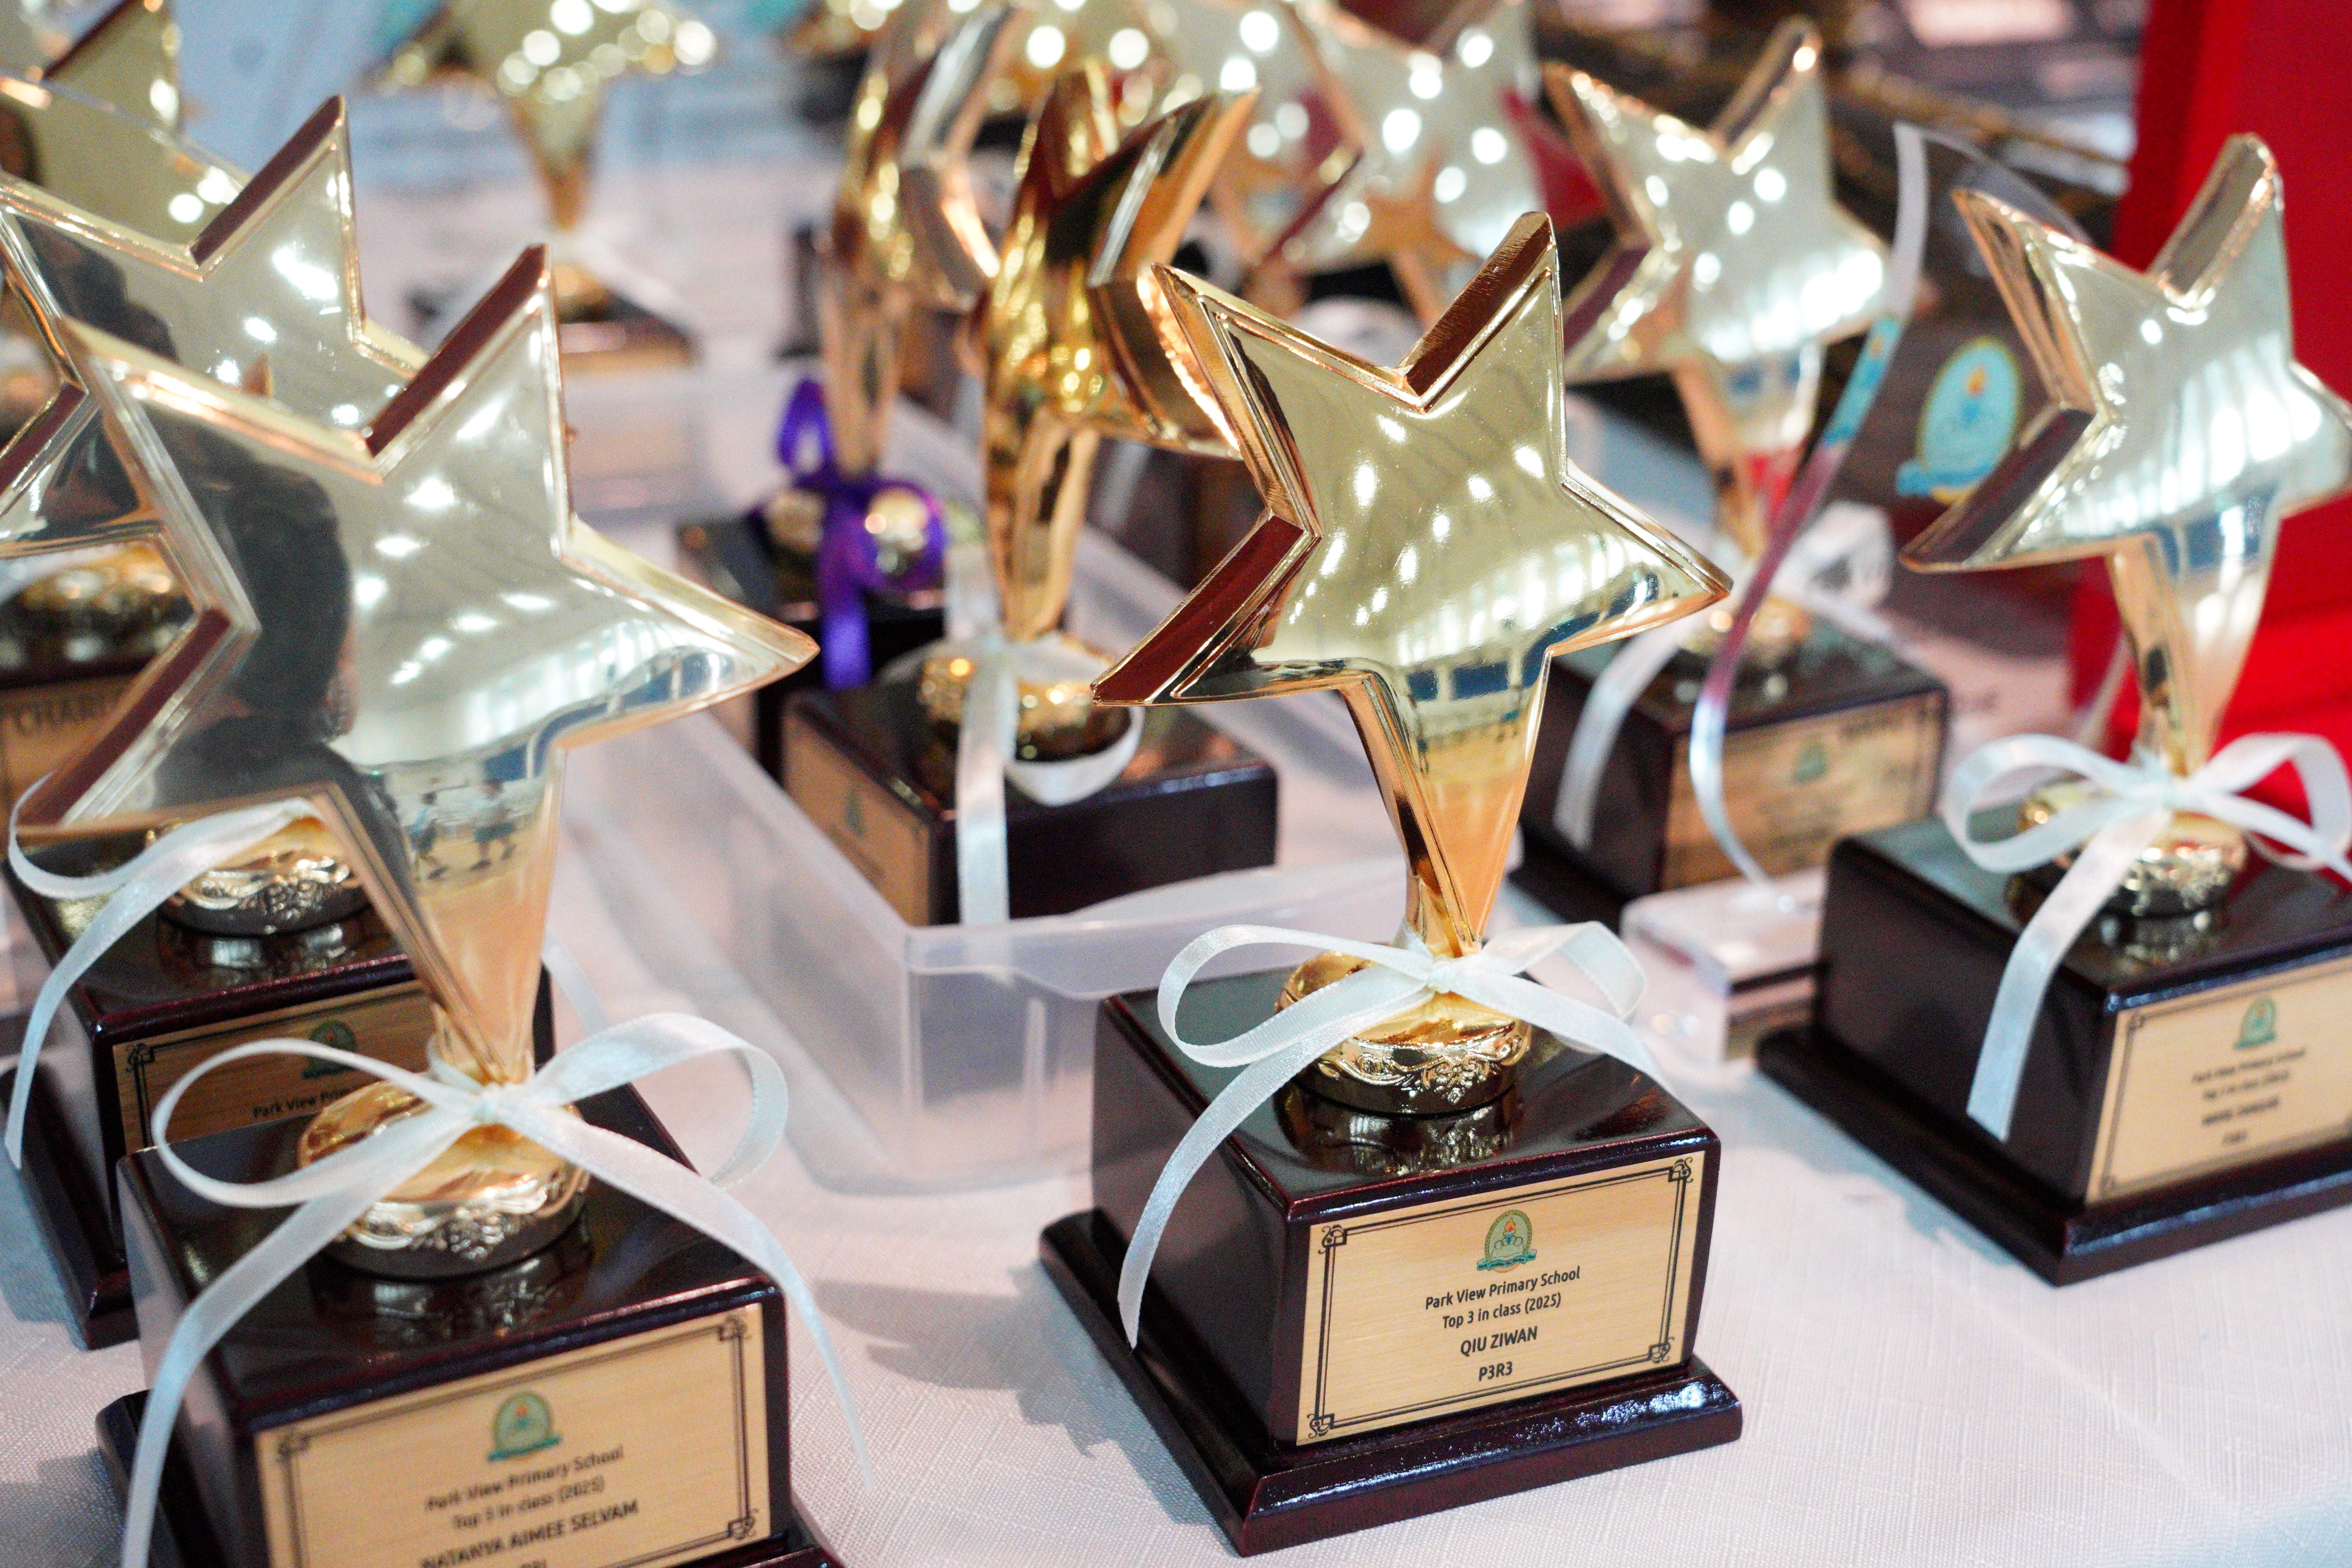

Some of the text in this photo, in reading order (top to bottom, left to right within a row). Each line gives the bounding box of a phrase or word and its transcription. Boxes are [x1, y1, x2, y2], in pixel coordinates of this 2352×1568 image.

[1426, 1266, 1581, 1310] Park View Primary School
[1443, 1292, 1561, 1328] Top 3 in class (2025)
[1461, 1326, 1537, 1357] QIU ZIWAN
[1479, 1361, 1513, 1381] P3R3
[508, 1463, 570, 1489] Primary
[573, 1445, 624, 1471] School
[509, 1519, 565, 1549] AIMEE
[570, 1499, 639, 1532] SELVAM
